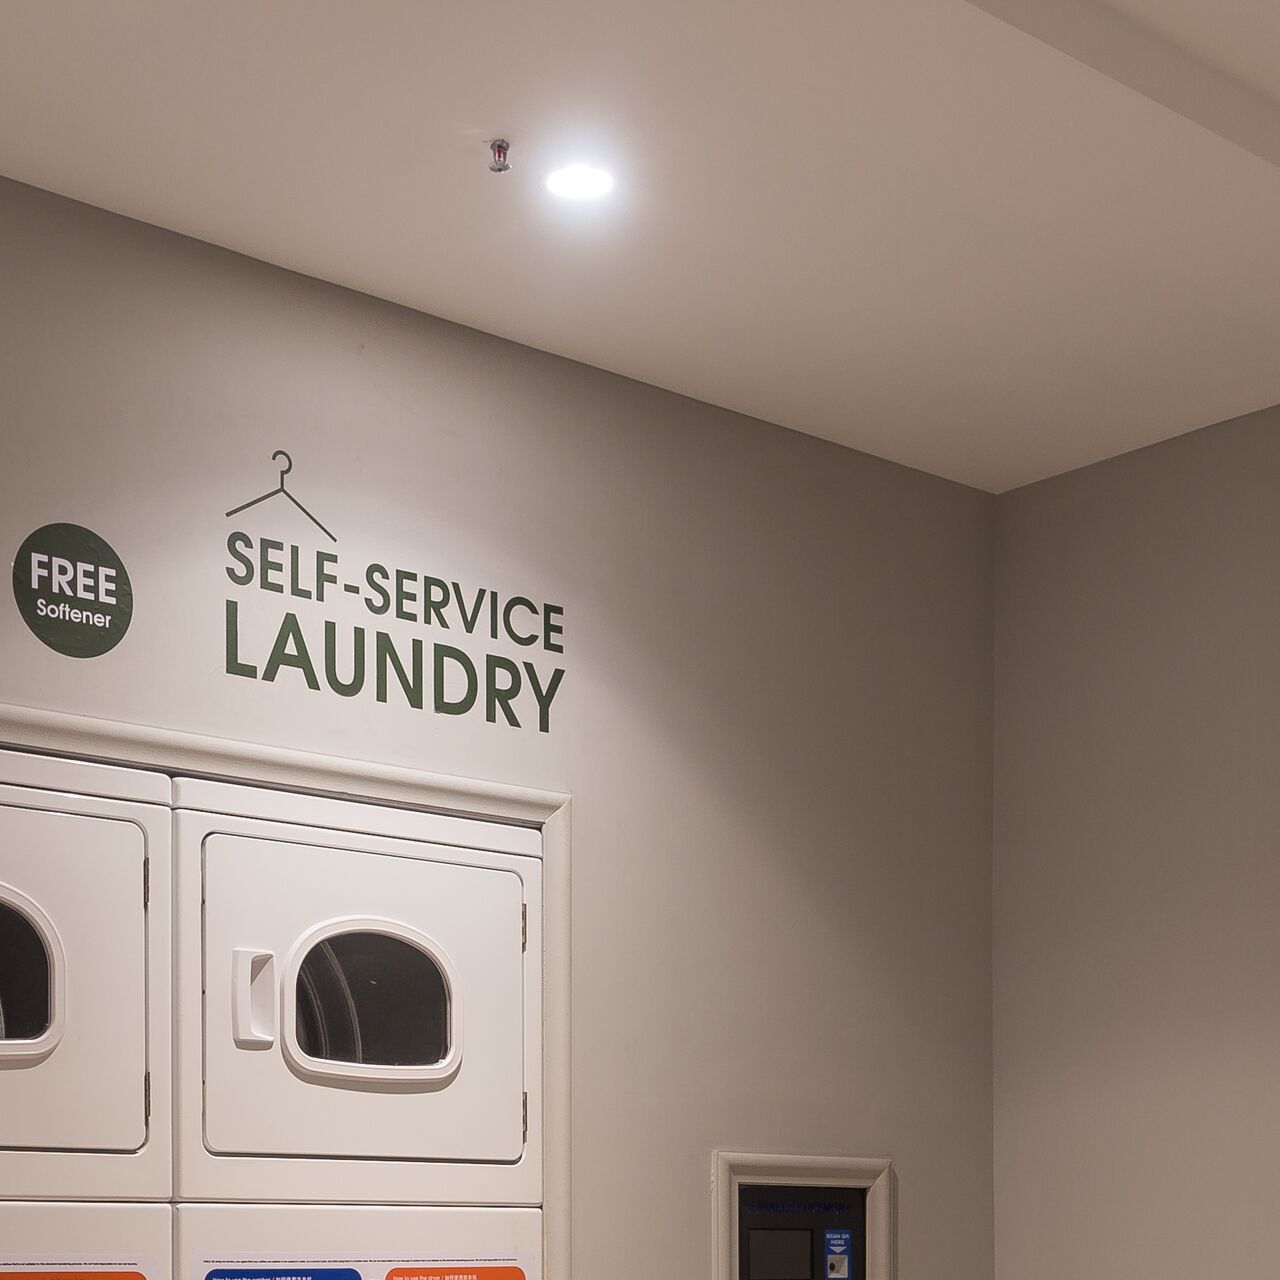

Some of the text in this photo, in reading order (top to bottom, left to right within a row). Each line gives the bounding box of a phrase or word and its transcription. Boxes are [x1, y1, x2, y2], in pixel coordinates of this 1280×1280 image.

[31, 552, 117, 605] FREE
[36, 598, 112, 629] Softener
[225, 531, 564, 654] SELF-SERVICE
[225, 599, 566, 733] LAUNDRY
